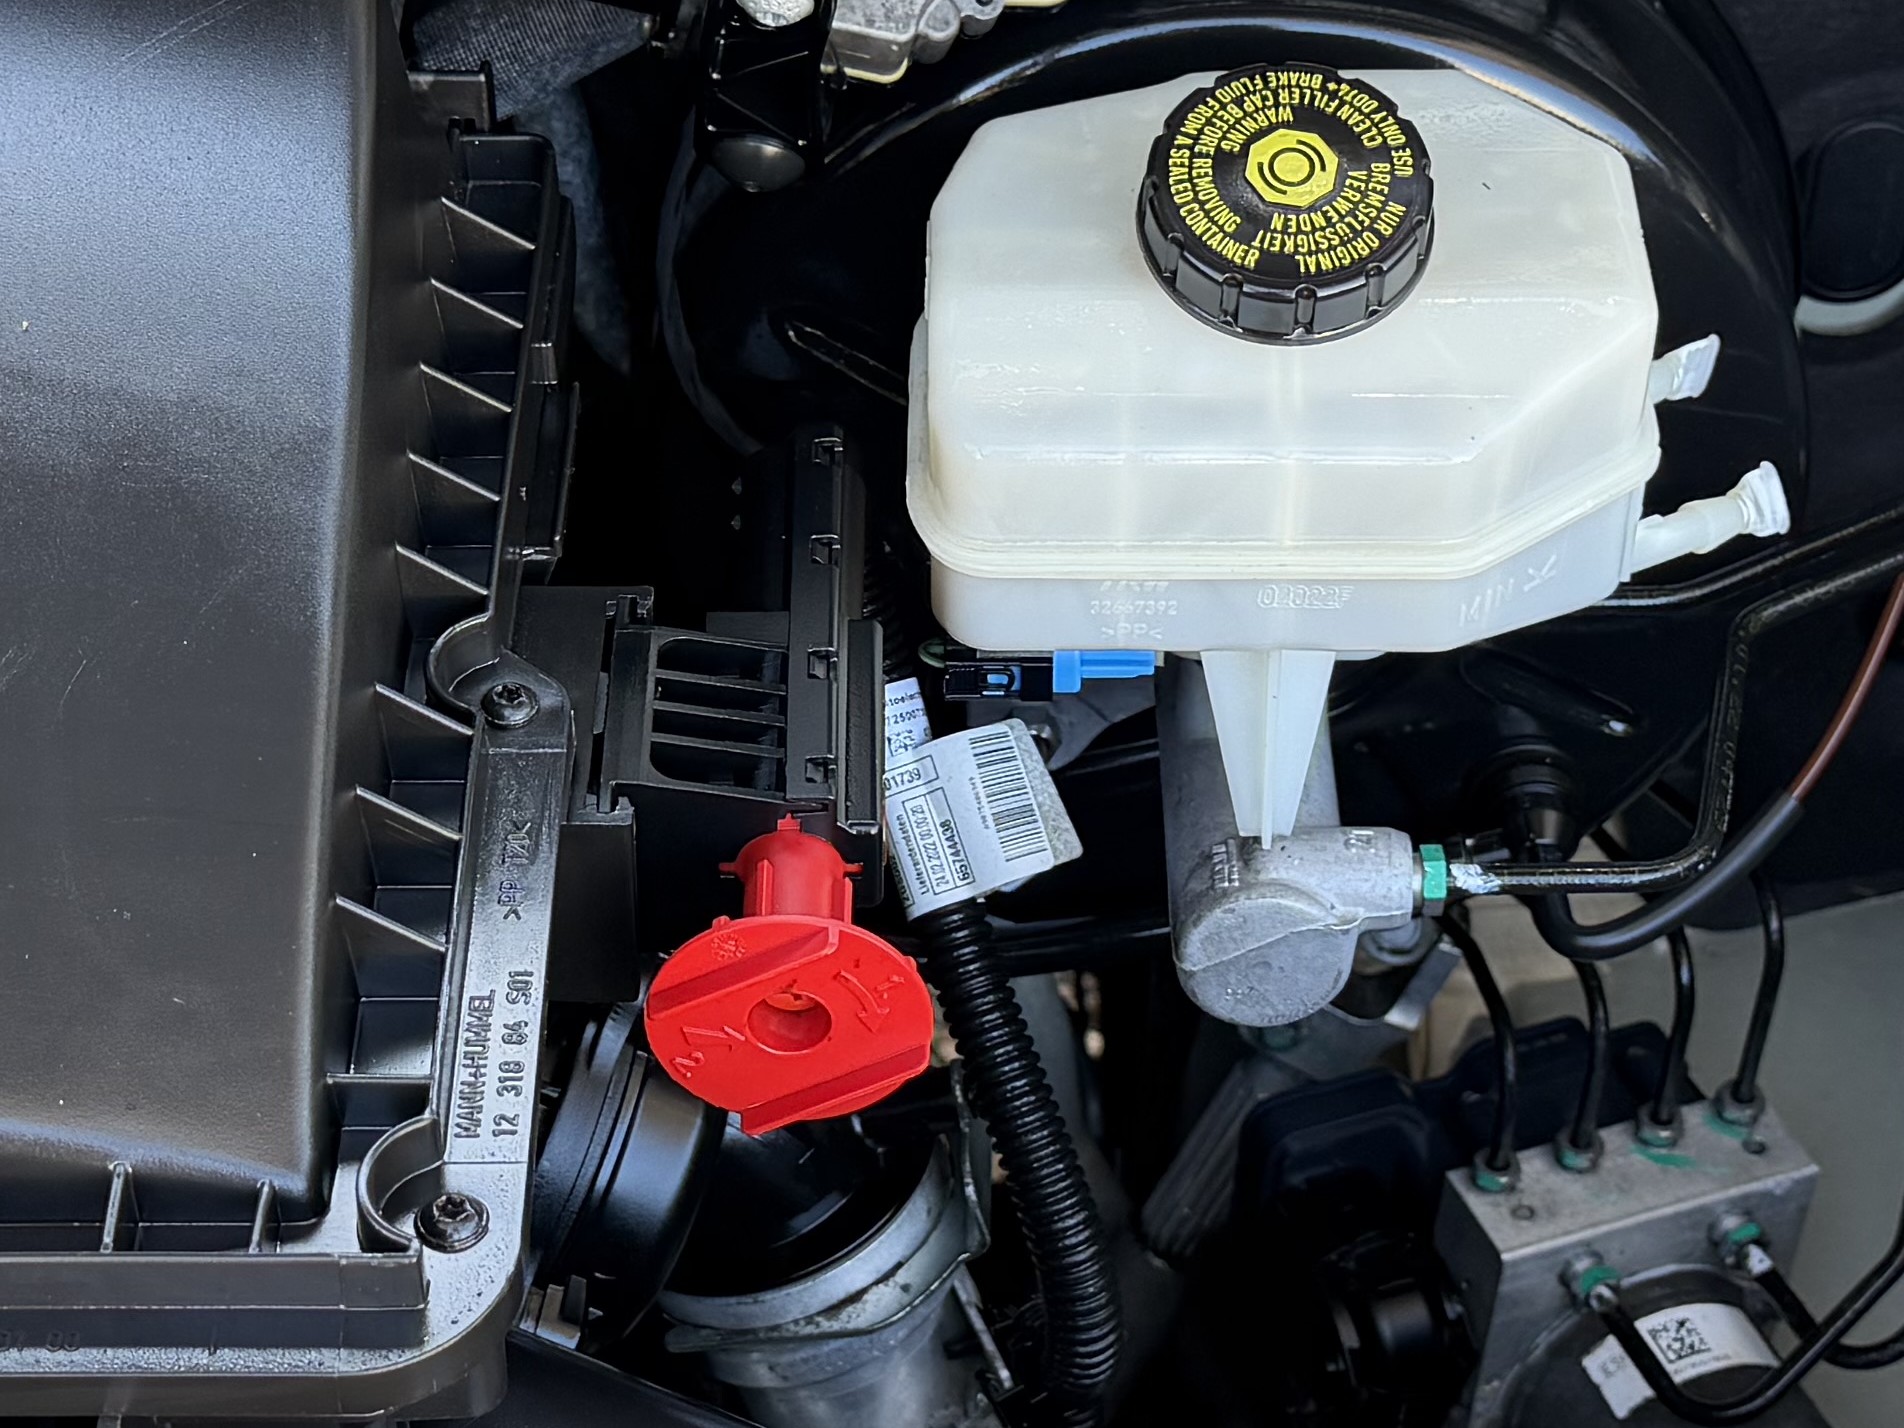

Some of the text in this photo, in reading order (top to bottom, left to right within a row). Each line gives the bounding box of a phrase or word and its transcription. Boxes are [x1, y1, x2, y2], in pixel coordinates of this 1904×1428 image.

[1215, 74, 1263, 102] FLUID
[1266, 71, 1322, 86] BRAKE
[1180, 97, 1219, 134] FROM
[1220, 106, 1293, 151] WARNING
[1370, 111, 1405, 147] ONLY
[1173, 134, 1193, 144] A
[1168, 148, 1193, 204] SEALED
[1192, 88, 1383, 232] CLEAN FILLER CAP BEFORE REMOVING
[1391, 147, 1413, 177] USE
[1270, 170, 1367, 231] VERWENDEN
[1179, 203, 1260, 267] CONTAINER
[1294, 201, 1406, 273] NUR ORIGINAL
[454, 989, 496, 1139] MANN+HUMMEL
[497, 1060, 525, 1098] 318
[492, 1113, 520, 1137] 12
